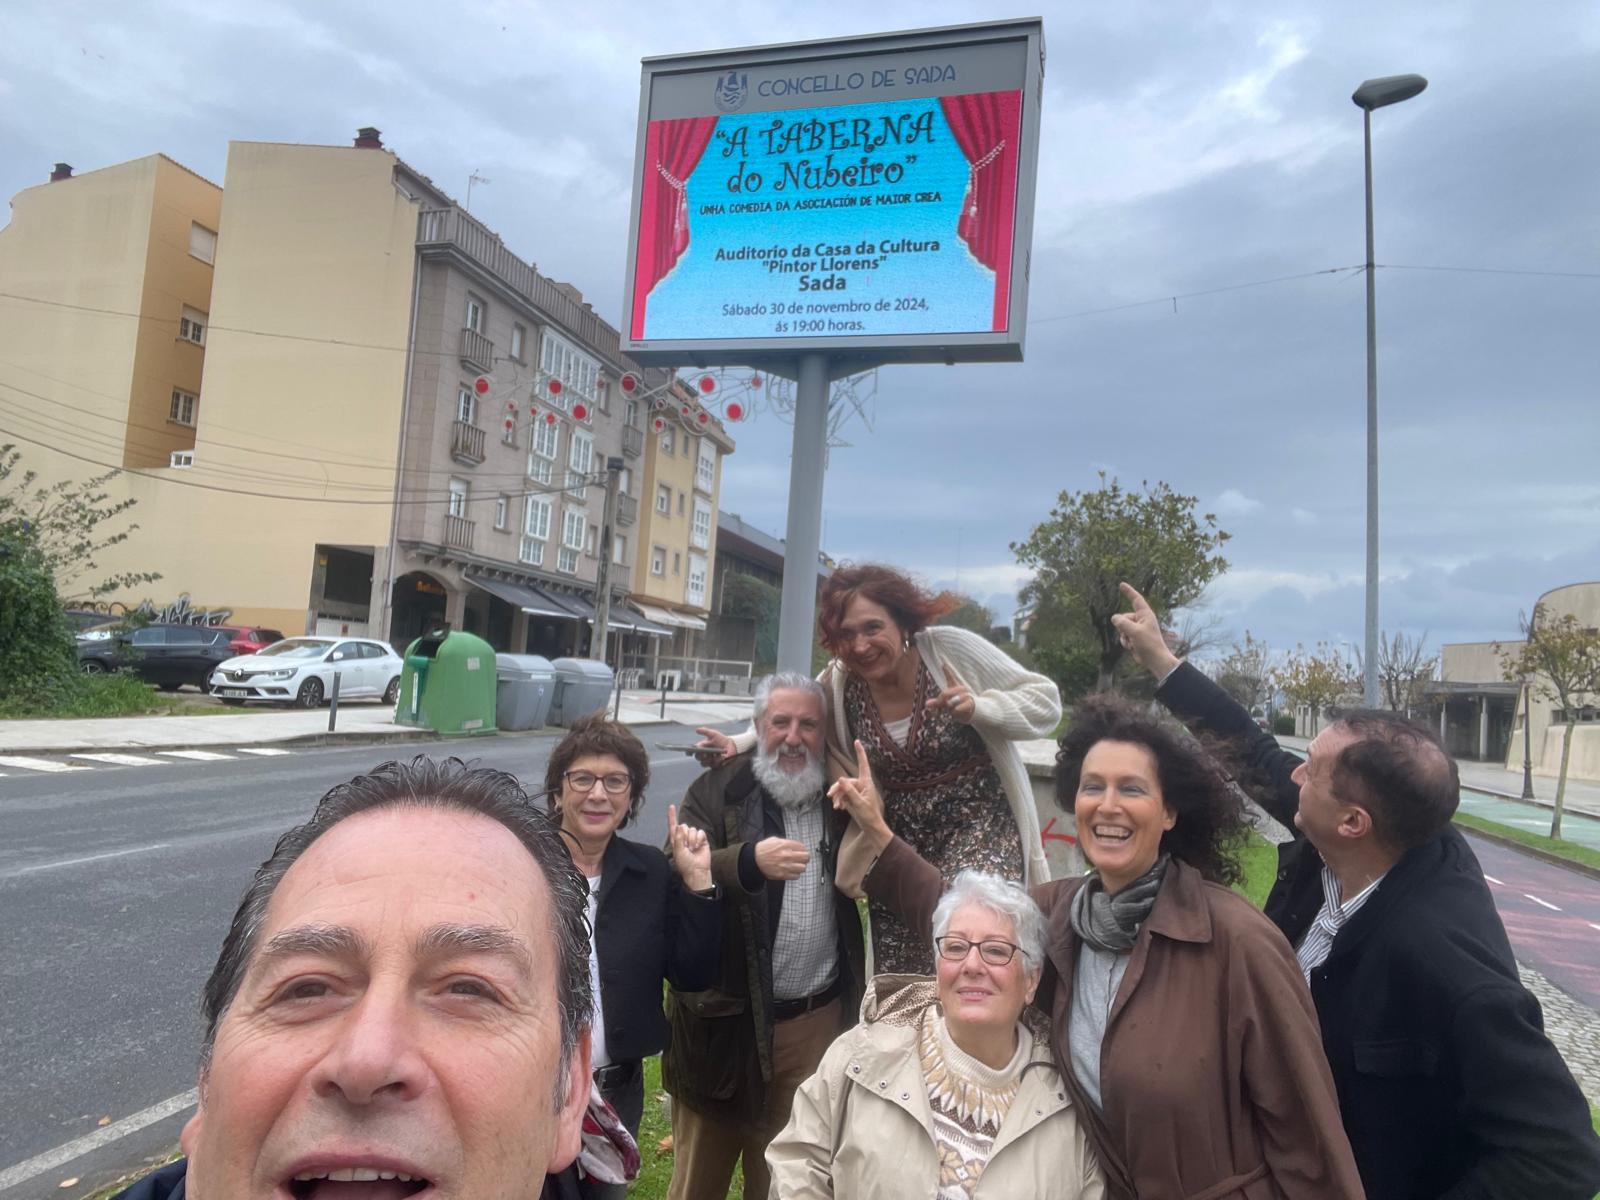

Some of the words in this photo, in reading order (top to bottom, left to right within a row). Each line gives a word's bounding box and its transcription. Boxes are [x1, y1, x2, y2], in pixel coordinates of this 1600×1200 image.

[758, 72, 864, 97] CONCELLO
[871, 69, 897, 88] DE
[904, 64, 956, 85] SADA
[759, 111, 935, 155] TABERNA
[727, 161, 763, 193] do
[700, 203, 726, 216] UNHA
[729, 201, 772, 214] COMEDIA
[776, 200, 791, 212] DA
[859, 195, 873, 207] DE
[714, 245, 788, 262] Auditorio
[791, 244, 811, 258] da
[814, 243, 851, 257] Casa
[855, 241, 876, 255] da
[879, 239, 940, 254] Cultura
[798, 274, 847, 292] Sada
[722, 303, 767, 317] Sábado
[769, 303, 785, 316] 30
[788, 301, 804, 315] de
[806, 299, 872, 314] novembro
[874, 299, 891, 312] de
[792, 319, 825, 332] 19:00
[827, 319, 866, 332] horas.
